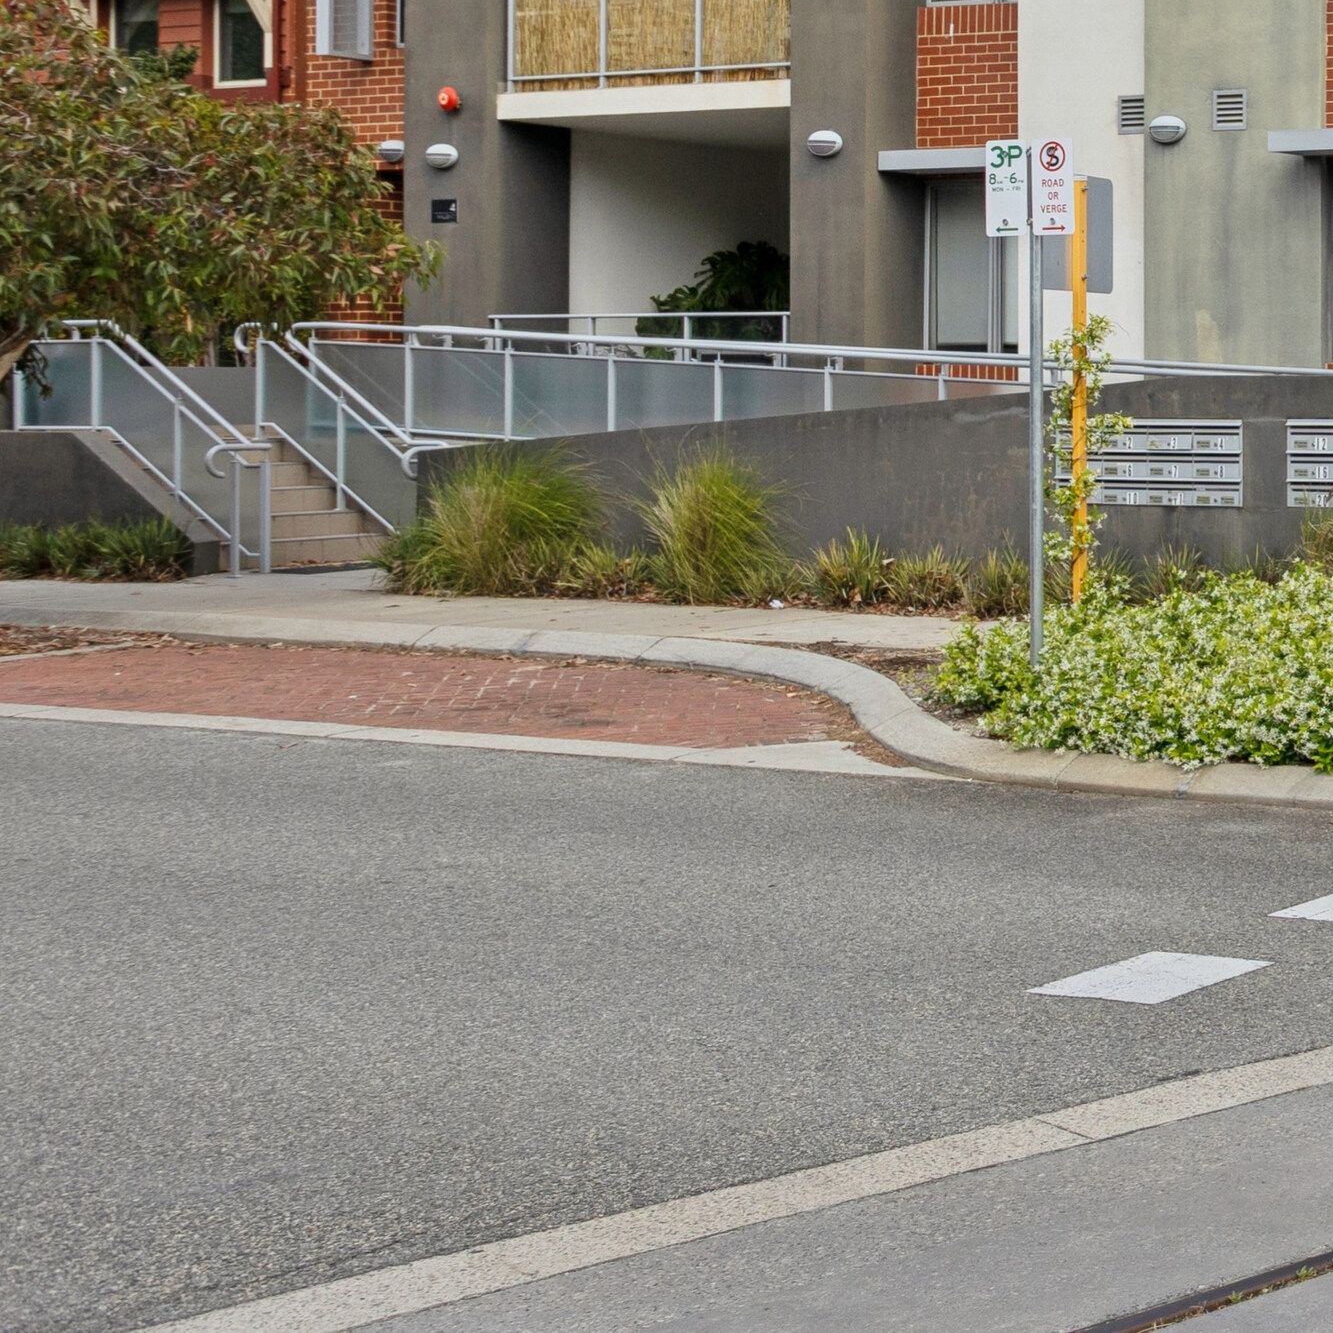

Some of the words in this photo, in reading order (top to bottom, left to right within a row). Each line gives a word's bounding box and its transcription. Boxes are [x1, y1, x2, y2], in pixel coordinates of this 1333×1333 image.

[990, 145, 1023, 168] 3P
[1041, 179, 1065, 188] ROAD
[1047, 191, 1059, 201] OR
[1040, 204, 1067, 214] VERGE
[1315, 437, 1327, 450] 12
[1317, 466, 1328, 479] 16
[1127, 492, 1139, 504] 10
